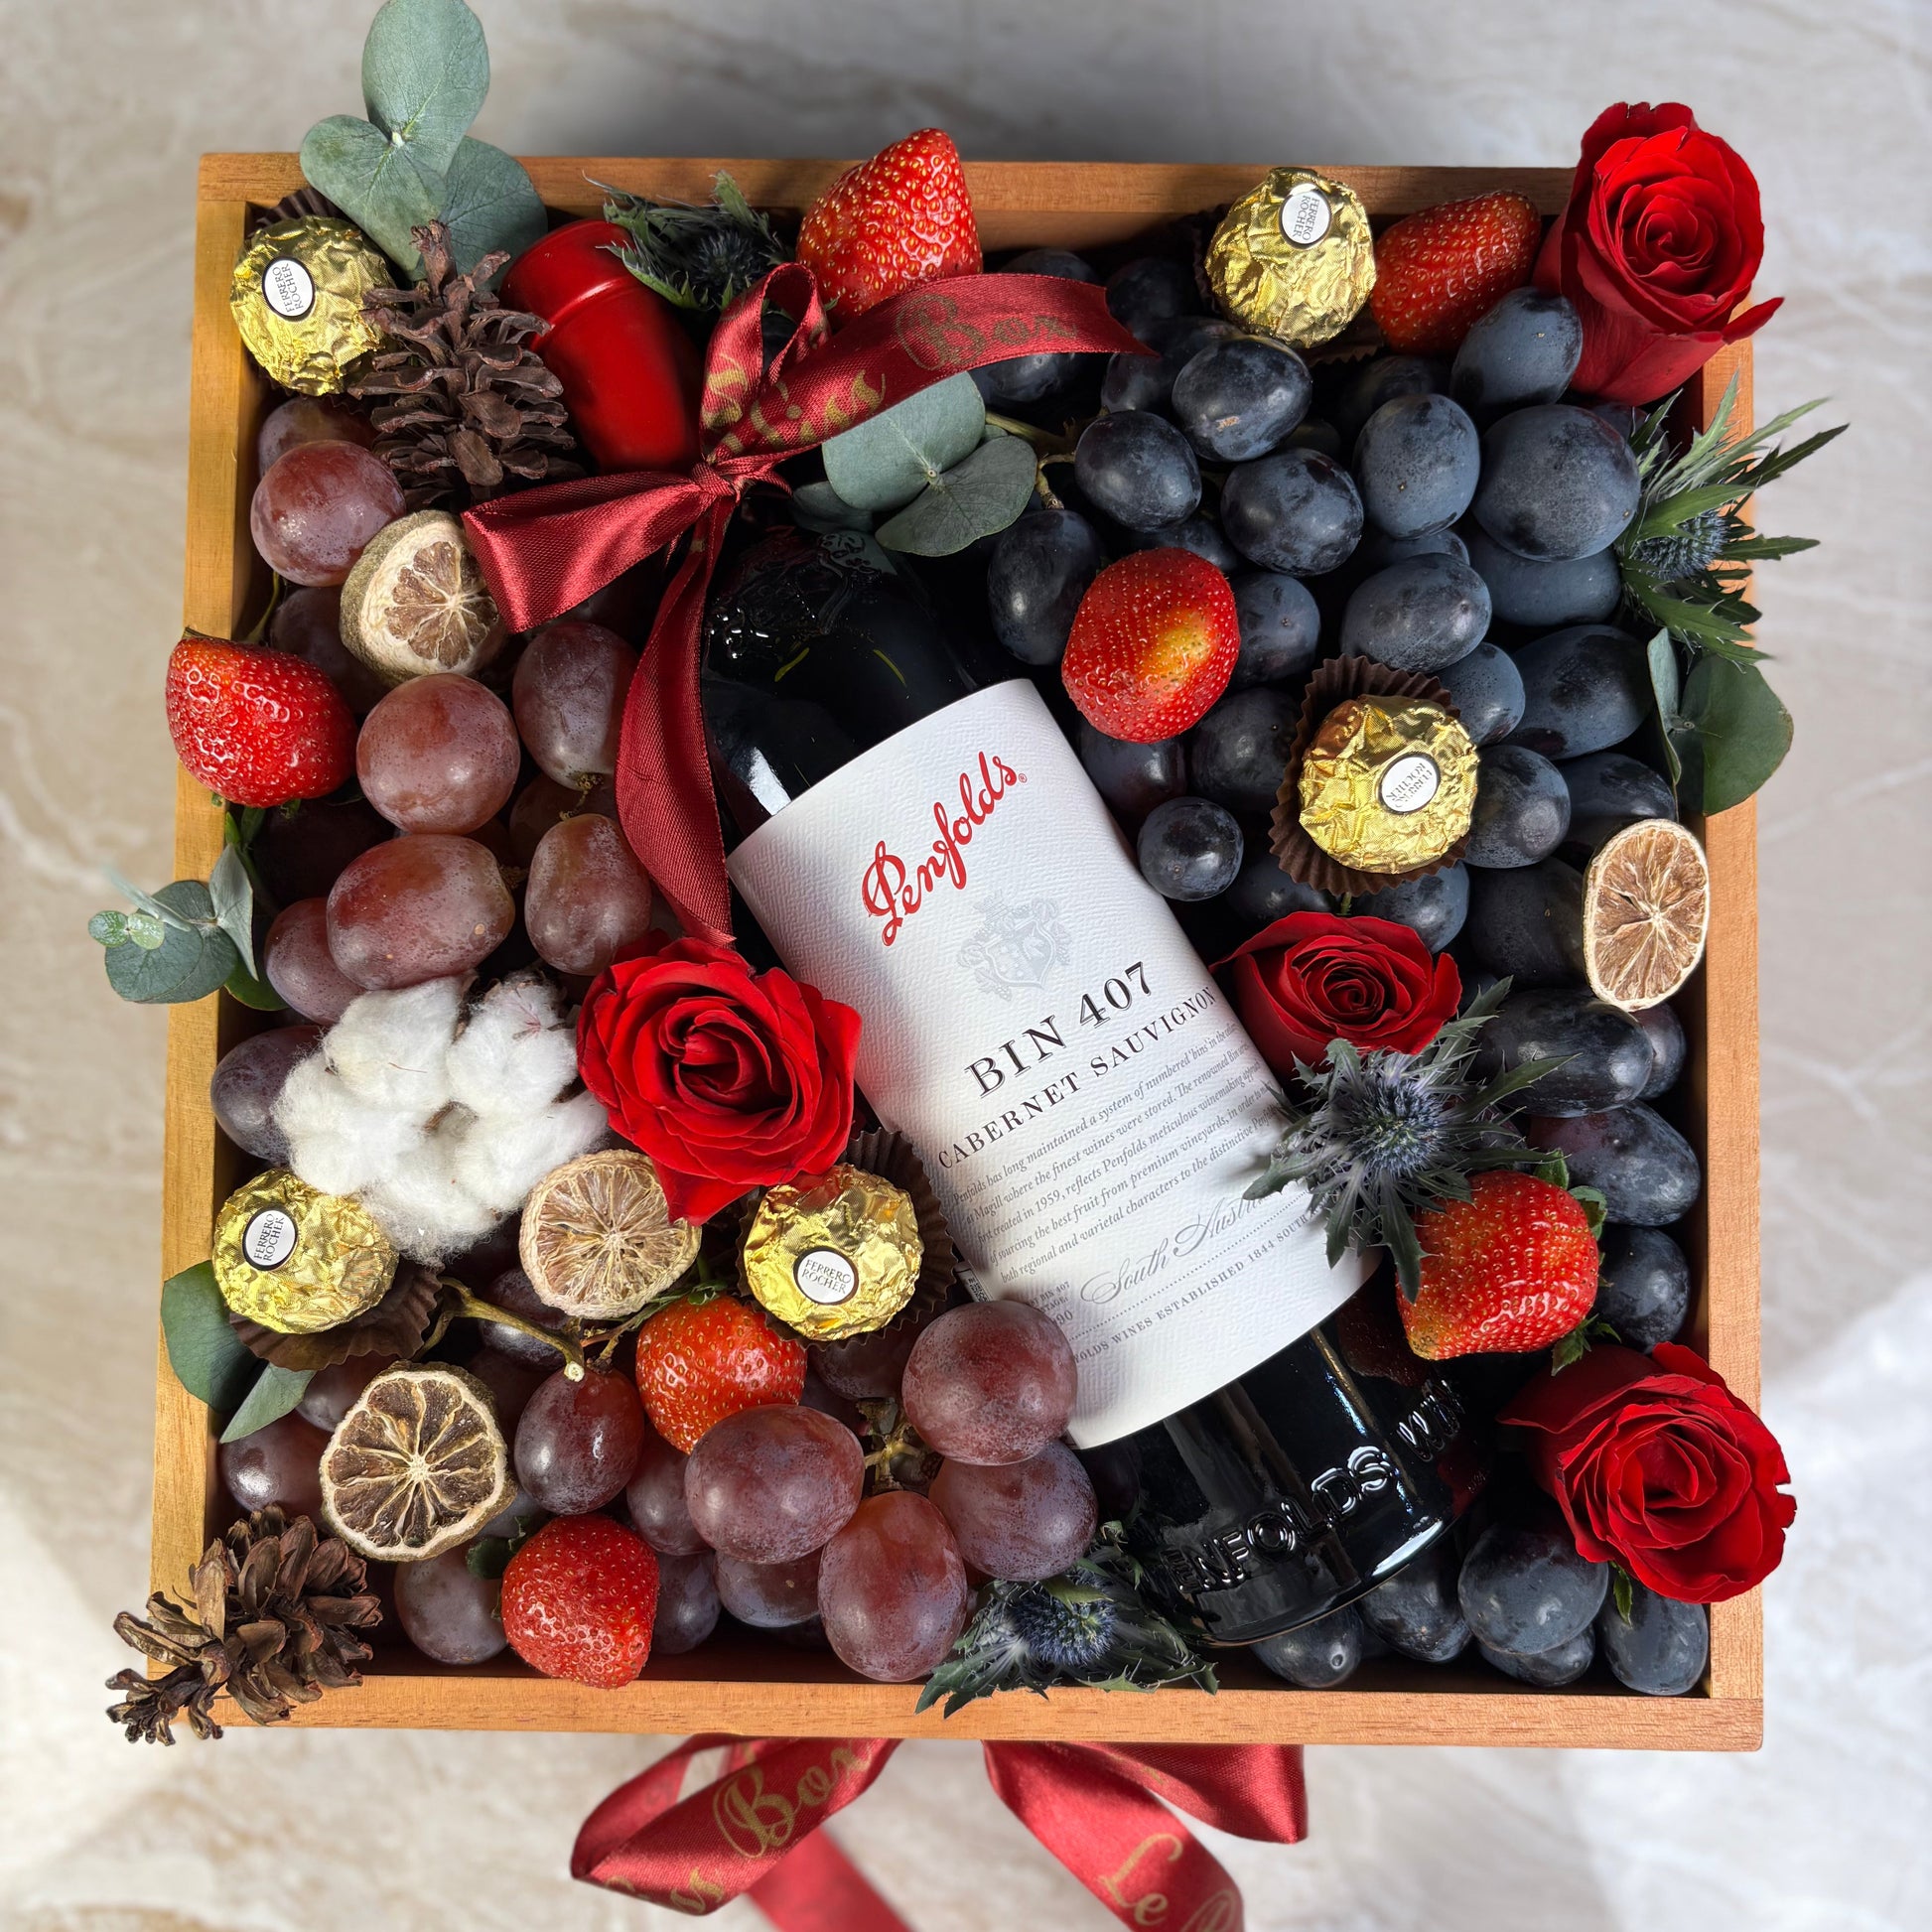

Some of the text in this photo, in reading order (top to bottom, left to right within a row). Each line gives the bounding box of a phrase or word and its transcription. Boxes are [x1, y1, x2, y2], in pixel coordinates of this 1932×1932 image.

[1292, 195, 1311, 237] ROCHER
[1302, 197, 1320, 241] FERRERO
[272, 266, 295, 313] FERRERO
[281, 263, 304, 310] ROCHER
[895, 292, 1077, 371] Box
[862, 752, 1018, 947] Penfolds
[963, 961, 1152, 1098] BIN 407
[938, 986, 1219, 1170] CABERNET SAUVIGNON
[950, 1179, 987, 1206] Penfolds
[985, 1172, 1004, 1186] has
[1002, 1159, 1028, 1177] long
[1026, 1117, 1088, 1164] maintained
[1098, 1093, 1133, 1123] system
[1133, 1080, 1145, 1101] of
[1145, 1053, 1191, 1090] numbered
[973, 1194, 1004, 1220] Magill
[1004, 1180, 1035, 1203] where
[1034, 1171, 1051, 1186] the
[1051, 1151, 1081, 1181] finest
[1082, 1132, 1116, 1157] wines
[1115, 1114, 1144, 1136] were
[1144, 1091, 1177, 1120] stored.
[1173, 1082, 1193, 1098] The
[1192, 1053, 1230, 1087] renowned
[1226, 1049, 1240, 1062] Bin
[993, 1210, 1024, 1237] created
[1022, 1207, 1035, 1220] in
[1035, 1189, 1066, 1213] 1959,
[1064, 1168, 1102, 1195] reflects
[1101, 1138, 1148, 1173] Penfolds
[1148, 1107, 1198, 1145] meticulous
[1197, 1075, 1246, 1111] winemaking
[990, 1249, 999, 1267] of
[998, 1235, 1036, 1260] sourcing
[1034, 1225, 1050, 1240] the
[1050, 1211, 1072, 1231] best
[1072, 1195, 1104, 1224] fruit
[1100, 1179, 1129, 1208] from
[1130, 1148, 1179, 1189] premium
[1179, 1115, 1230, 1152] vineyards,
[1226, 1108, 1239, 1120] in
[1237, 1094, 1255, 1113] order
[1000, 1266, 1019, 1284] both
[1019, 1245, 1057, 1275] regional
[1058, 1232, 1079, 1255] and
[1079, 1207, 1125, 1241] varietal
[1126, 1175, 1179, 1215] characters
[1179, 1169, 1191, 1181] to
[1191, 1157, 1208, 1173] the
[1209, 1125, 1253, 1162] distinctive
[253, 1213, 275, 1260] FERRERO
[263, 1217, 285, 1262] ROCHER
[801, 1269, 846, 1295] ROCHER
[805, 1259, 852, 1284] FERRERO
[1080, 1237, 1169, 1305] South
[1074, 1214, 1311, 1364] FOLDS WINES ESTABLISHED 1844 SOUTH
[1160, 1446, 1393, 1592] ENFOLDS
[1095, 1832, 1183, 1926] Le
